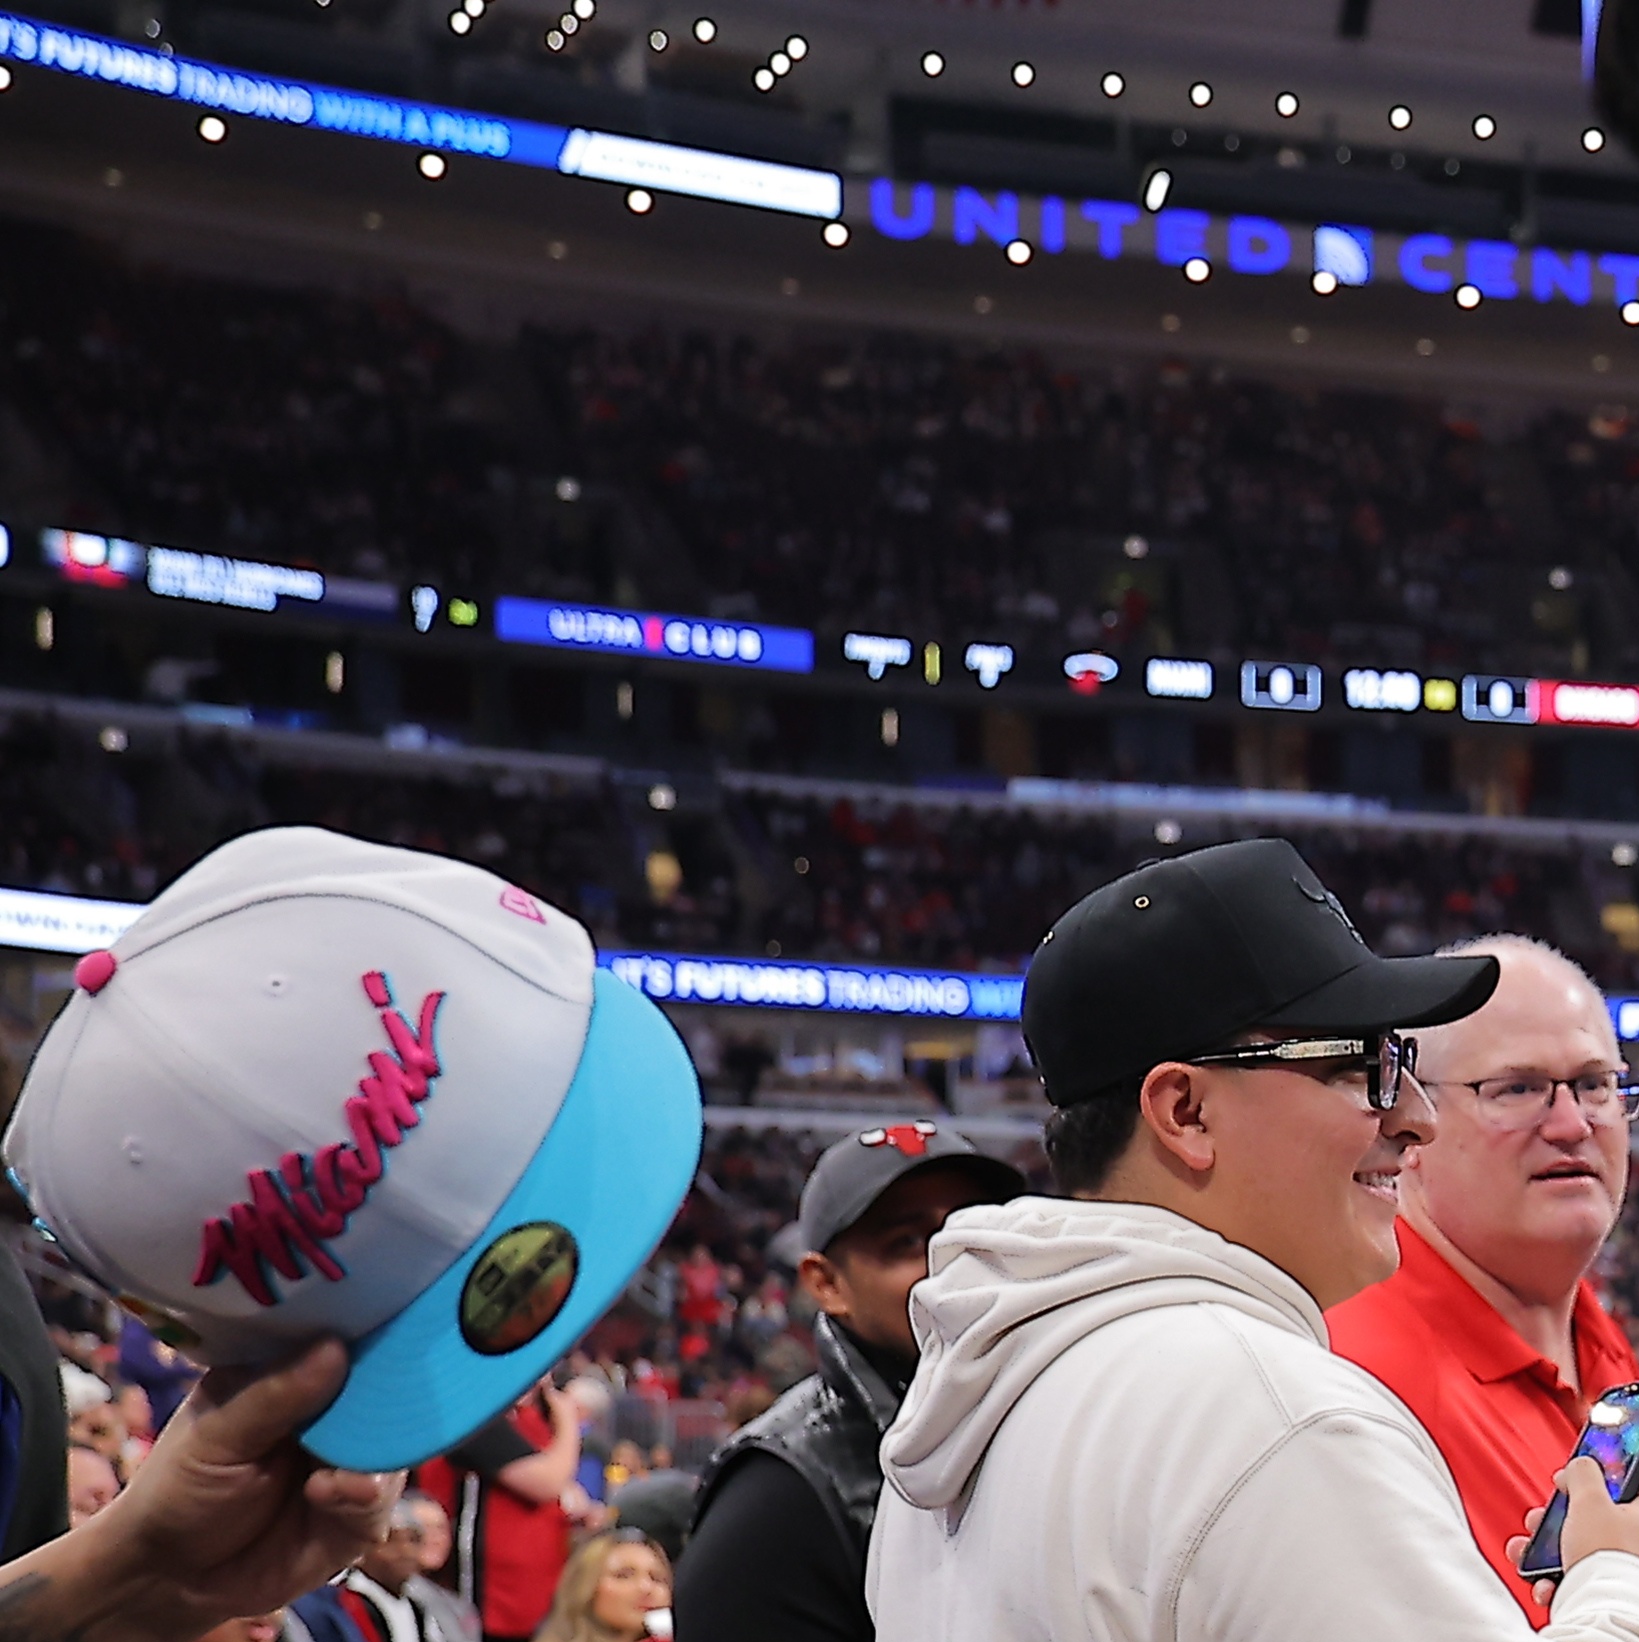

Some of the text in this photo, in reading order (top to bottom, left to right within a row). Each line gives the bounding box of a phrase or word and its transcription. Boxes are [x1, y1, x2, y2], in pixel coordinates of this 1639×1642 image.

[868, 179, 1290, 275] UNITED
[827, 968, 970, 1015] TRADING
[192, 969, 446, 1307] Miami
